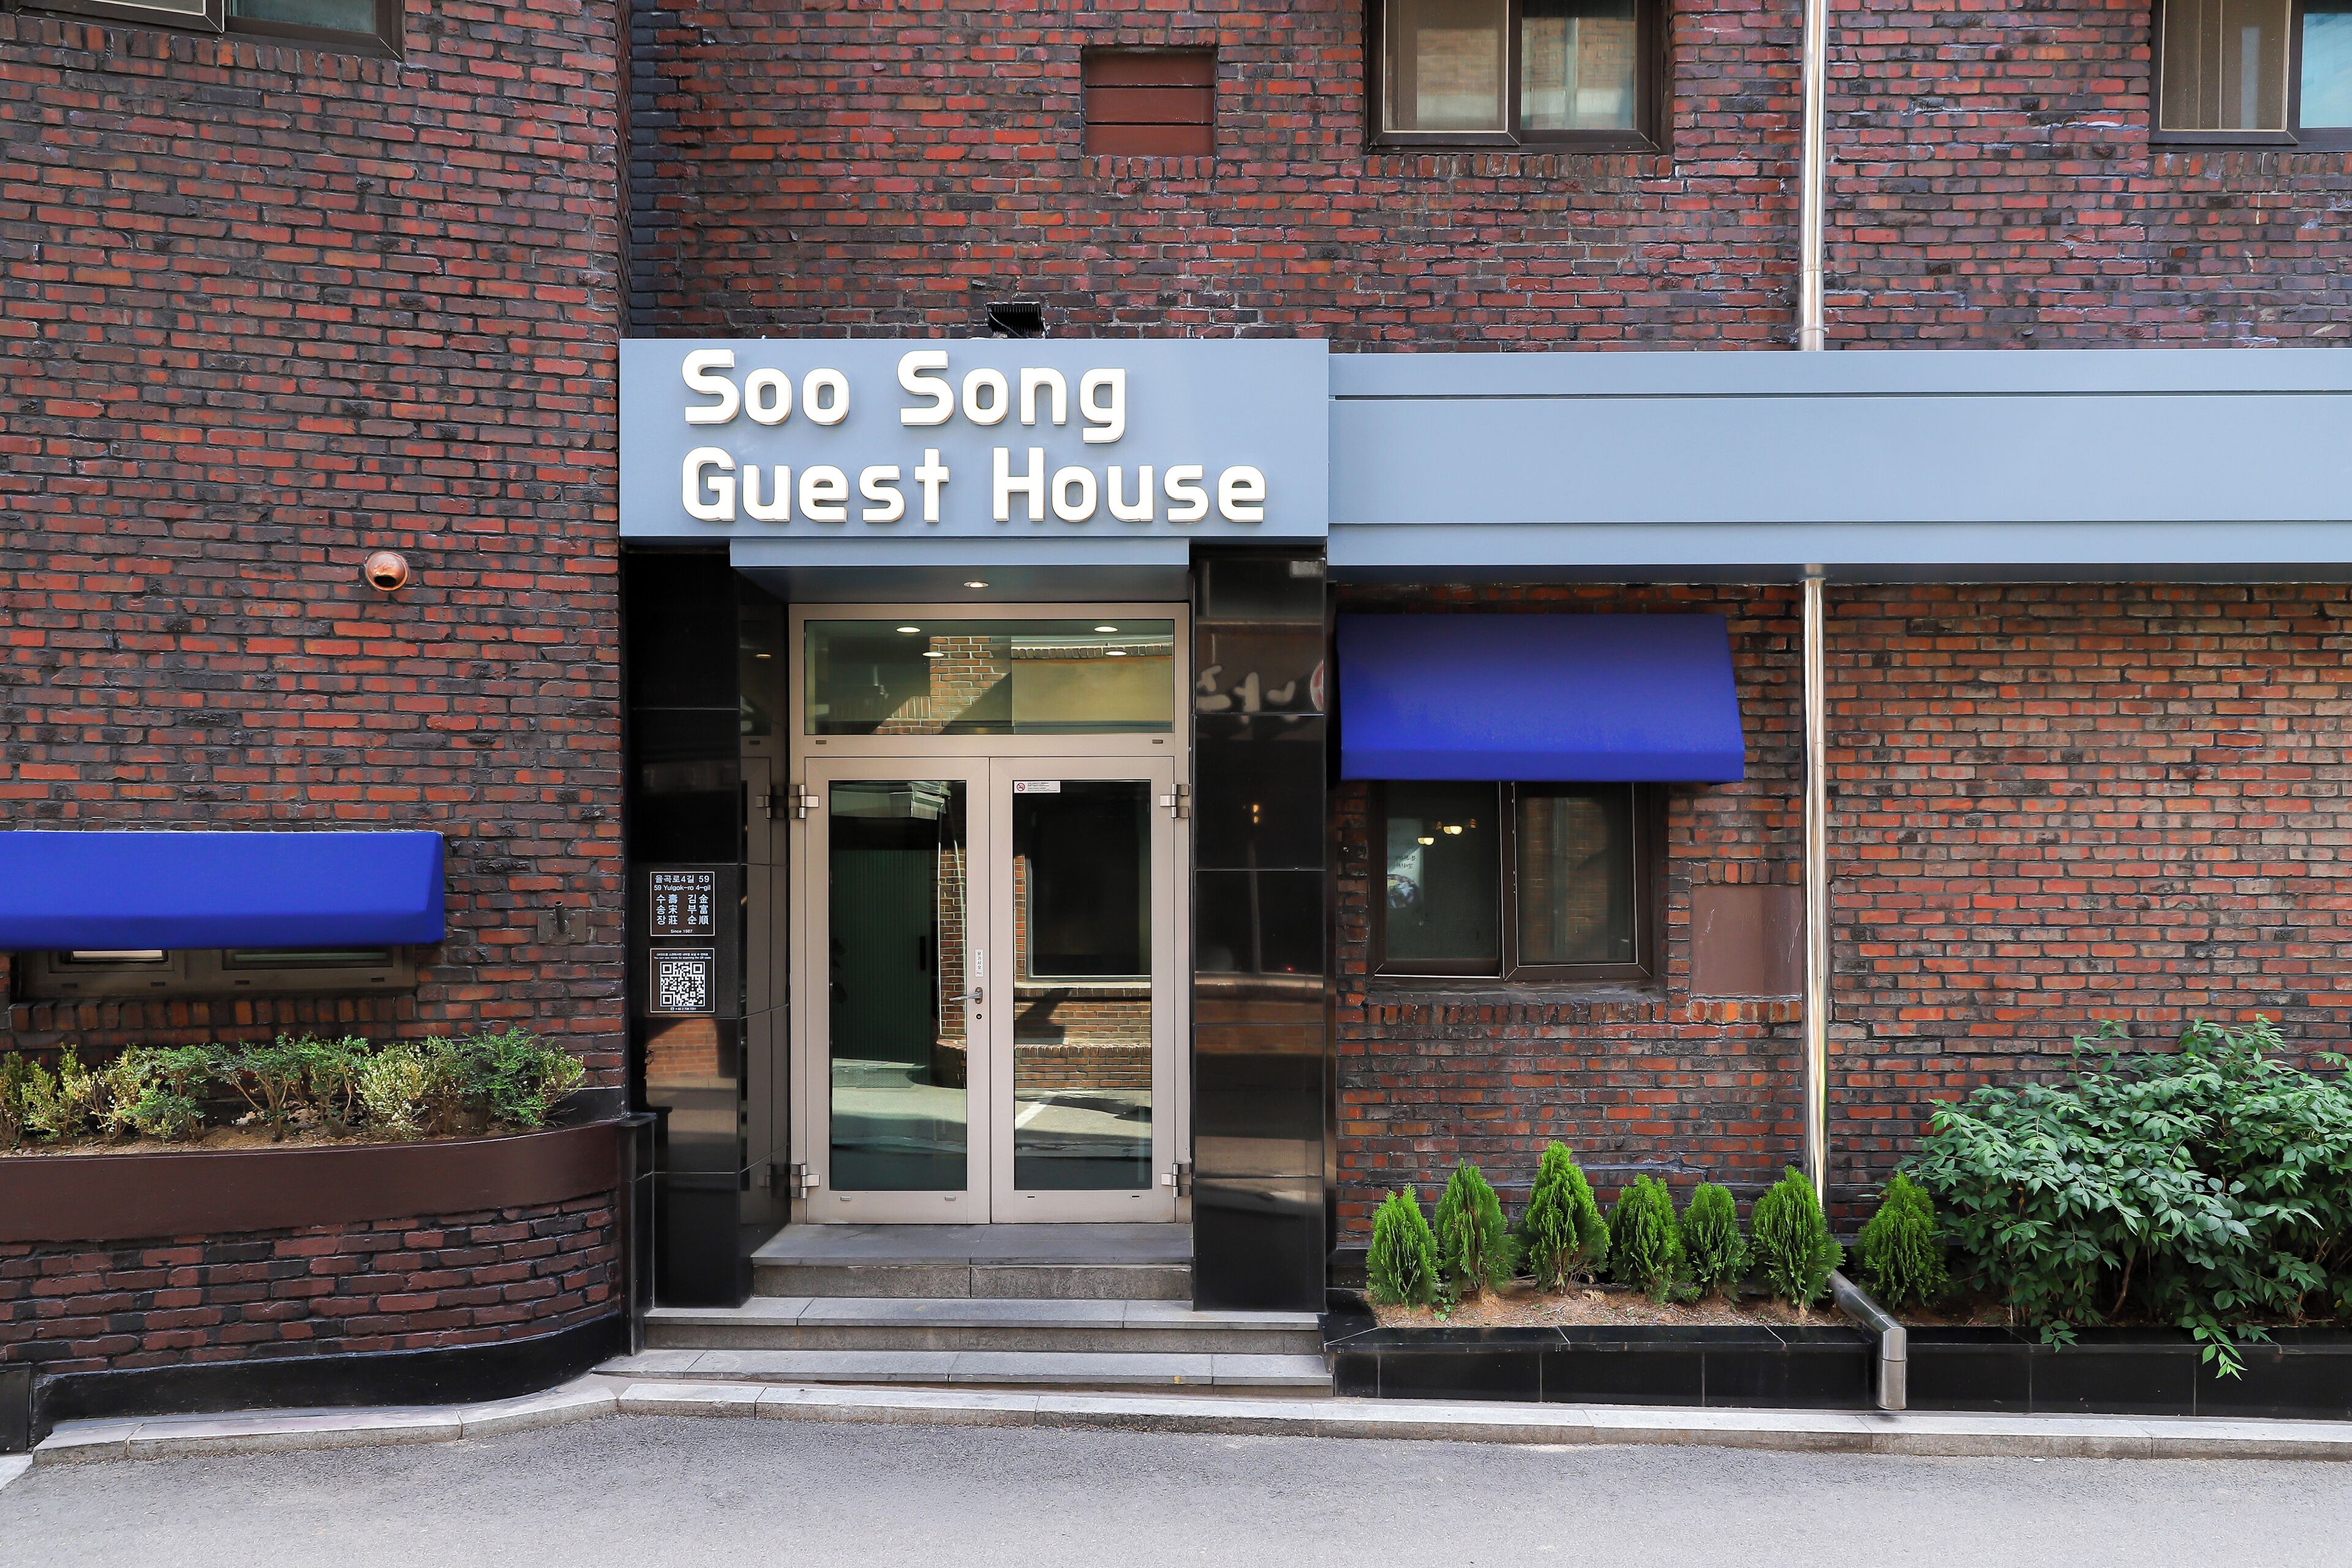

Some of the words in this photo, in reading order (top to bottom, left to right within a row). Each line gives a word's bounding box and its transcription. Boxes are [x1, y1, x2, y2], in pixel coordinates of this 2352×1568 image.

[681, 349, 851, 425] Soo
[897, 350, 1126, 443] Song
[682, 446, 950, 523] Guest
[992, 447, 1267, 523] House
[655, 875, 695, 883] 율곡로4길
[656, 894, 666, 925] 수송장
[687, 894, 697, 925] 김부순
